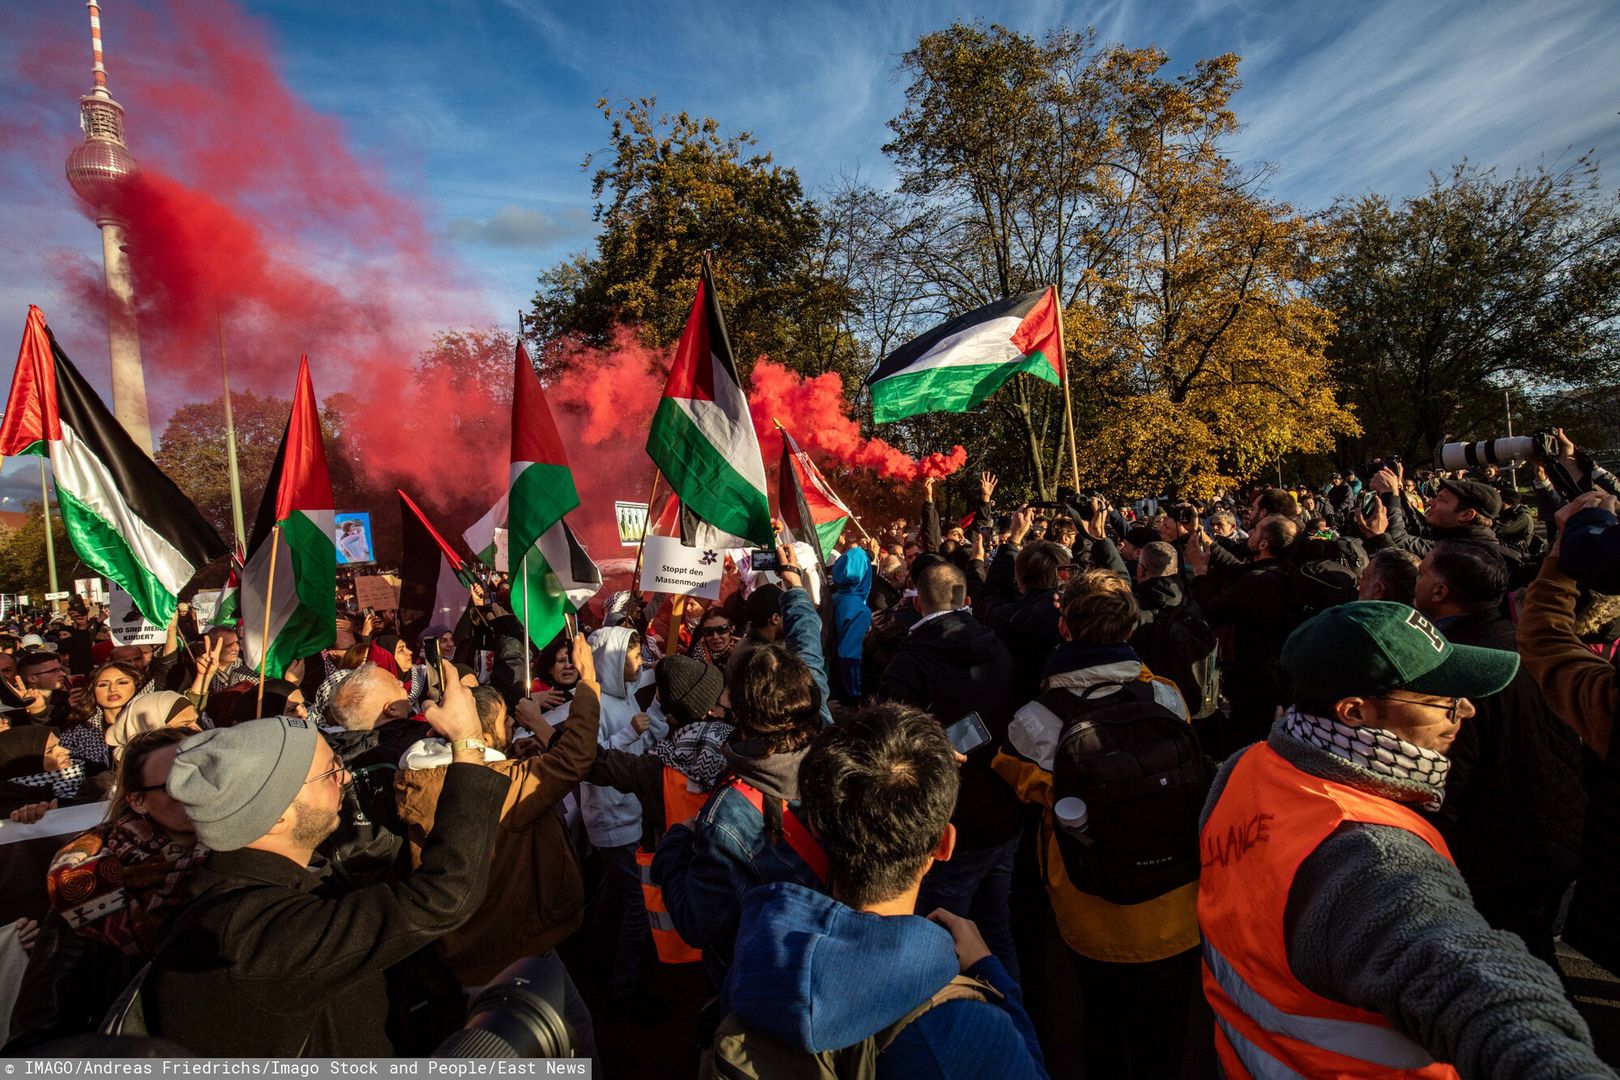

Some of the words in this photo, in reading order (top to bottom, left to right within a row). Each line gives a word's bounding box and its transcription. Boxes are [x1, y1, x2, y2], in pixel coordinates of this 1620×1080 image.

[662, 565, 688, 575] Stoppt
[689, 568, 704, 577] den
[655, 576, 707, 589] Massenmord!
[1405, 608, 1445, 652] P
[123, 633, 154, 641] KINDER?
